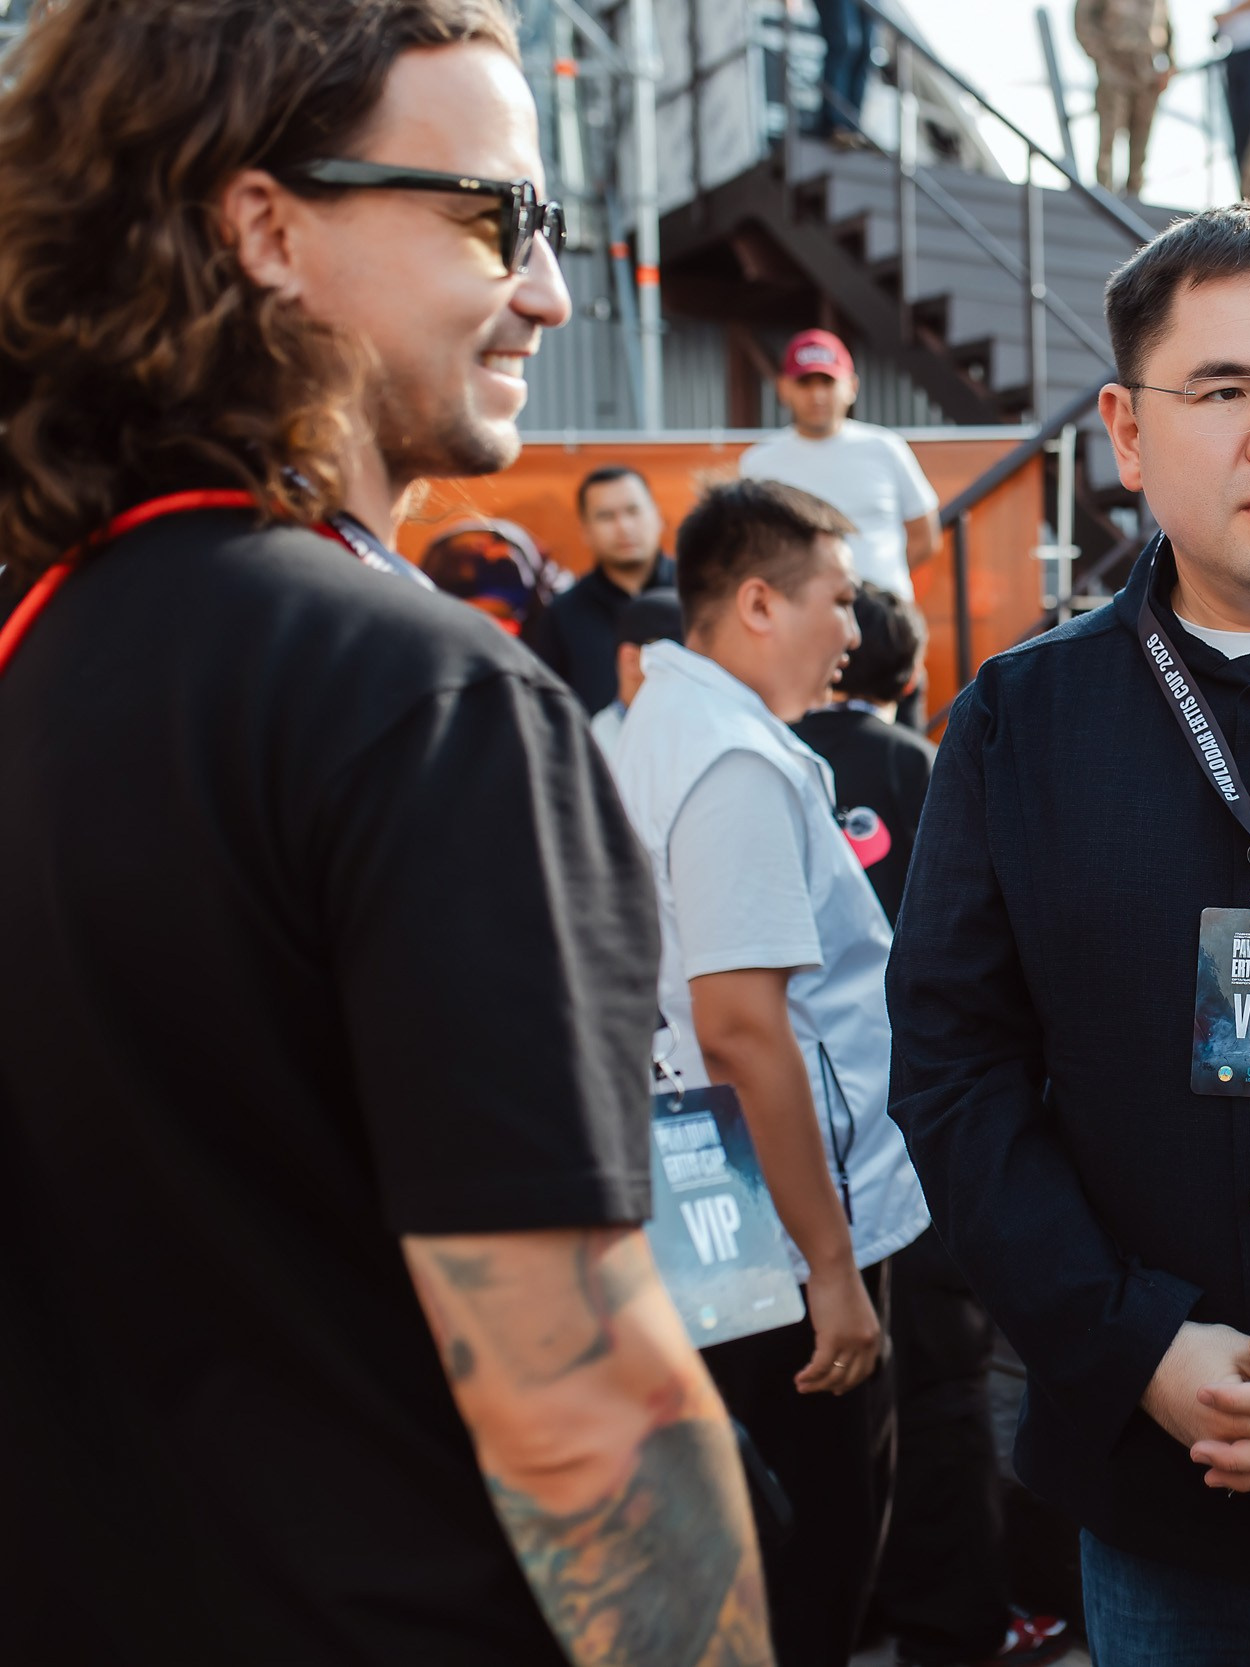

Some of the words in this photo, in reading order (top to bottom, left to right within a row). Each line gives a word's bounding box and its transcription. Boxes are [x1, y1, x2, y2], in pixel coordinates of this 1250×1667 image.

[1146, 633, 1175, 672] 2026
[1164, 670, 1190, 700] CUP
[1179, 695, 1210, 735] ERTIS
[1197, 728, 1240, 802] PAVLODAR
[680, 1192, 742, 1266] VIP
